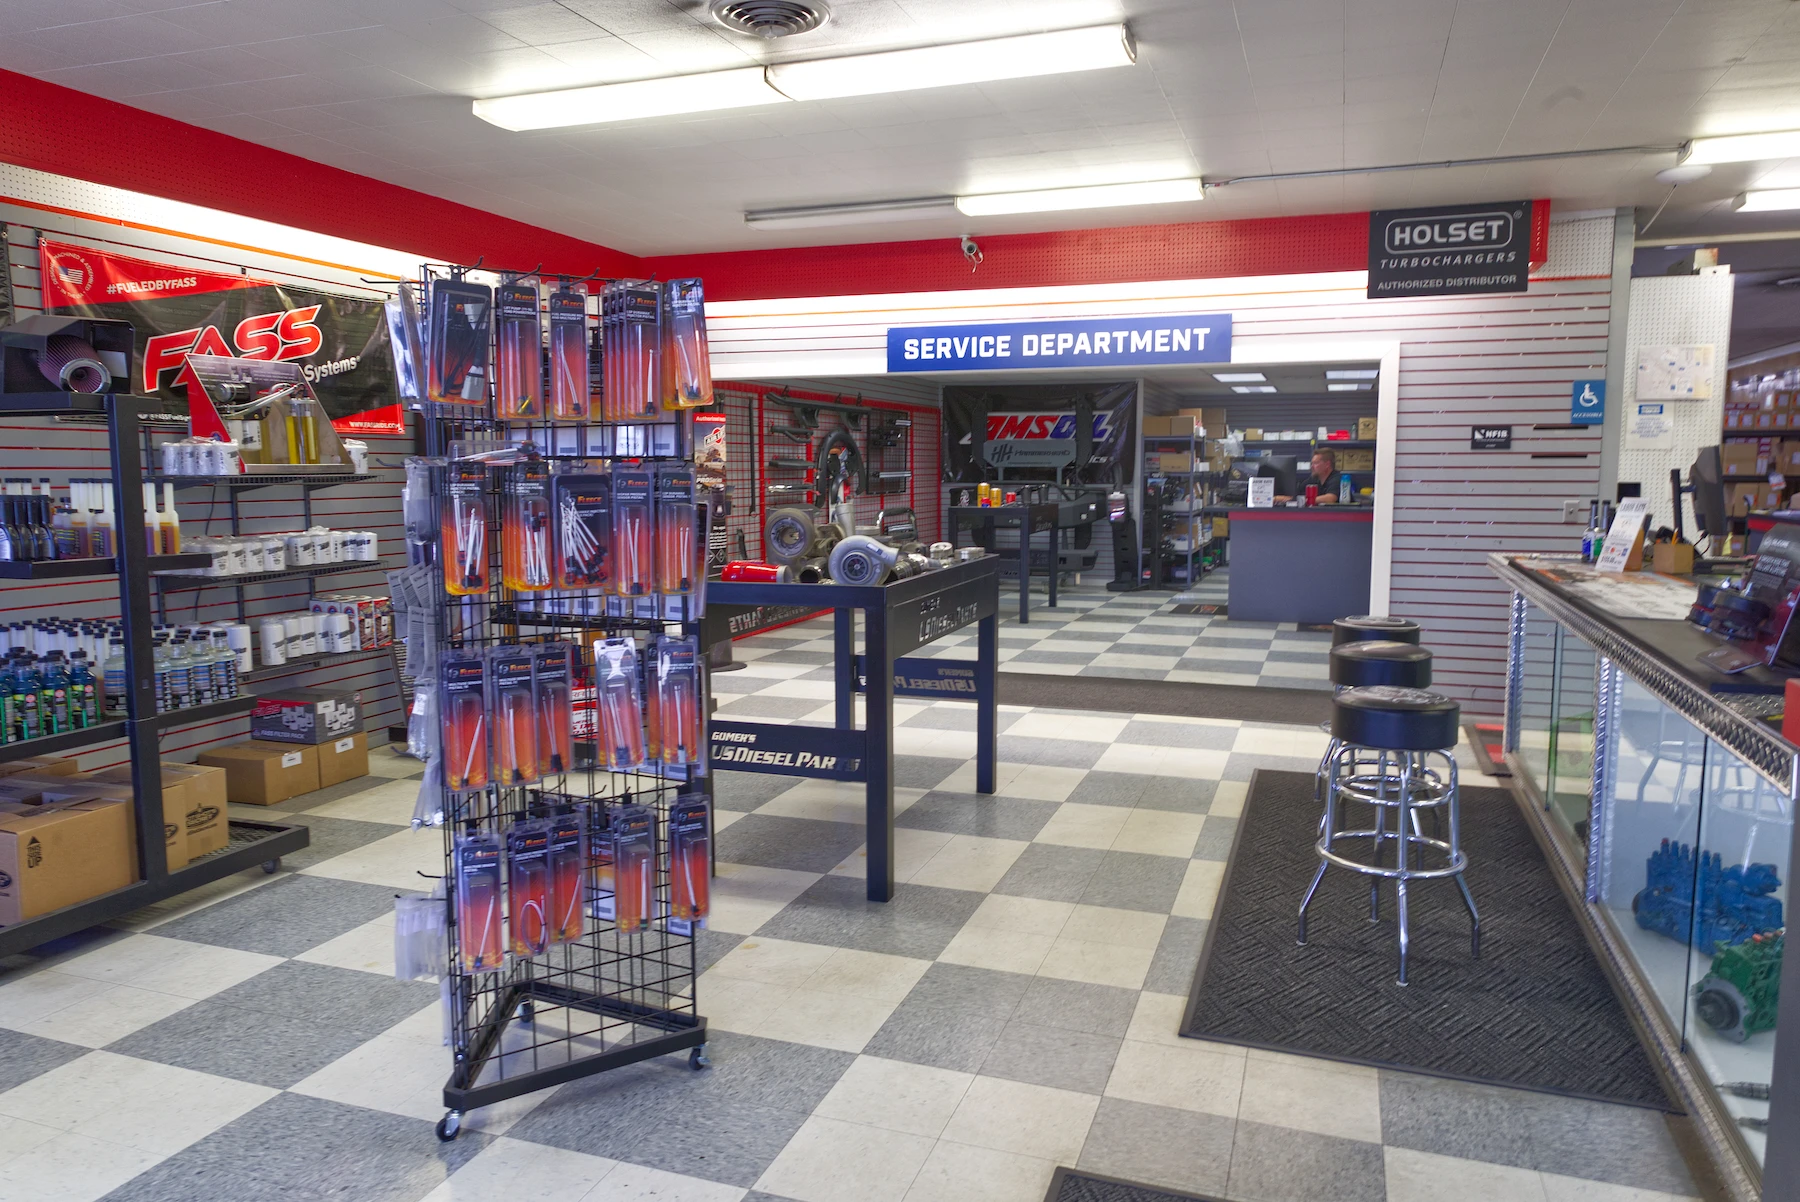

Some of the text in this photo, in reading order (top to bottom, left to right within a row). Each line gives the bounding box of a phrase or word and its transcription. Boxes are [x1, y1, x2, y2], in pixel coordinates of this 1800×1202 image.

[1393, 219, 1505, 247] HOLSET
[1380, 251, 1517, 270] TURBOCHARGERS
[106, 277, 197, 295] #FUELEDBYFASS
[1377, 274, 1517, 291] AUTHORIZED DISTRIBUTOR
[143, 304, 322, 393] FASS
[903, 327, 1211, 360] SERVICE DEPARTMENT
[959, 411, 1114, 444] AMSOL
[290, 731, 305, 739] PACK
[711, 731, 757, 744] GOMER'S
[27, 856, 43, 869] UP
